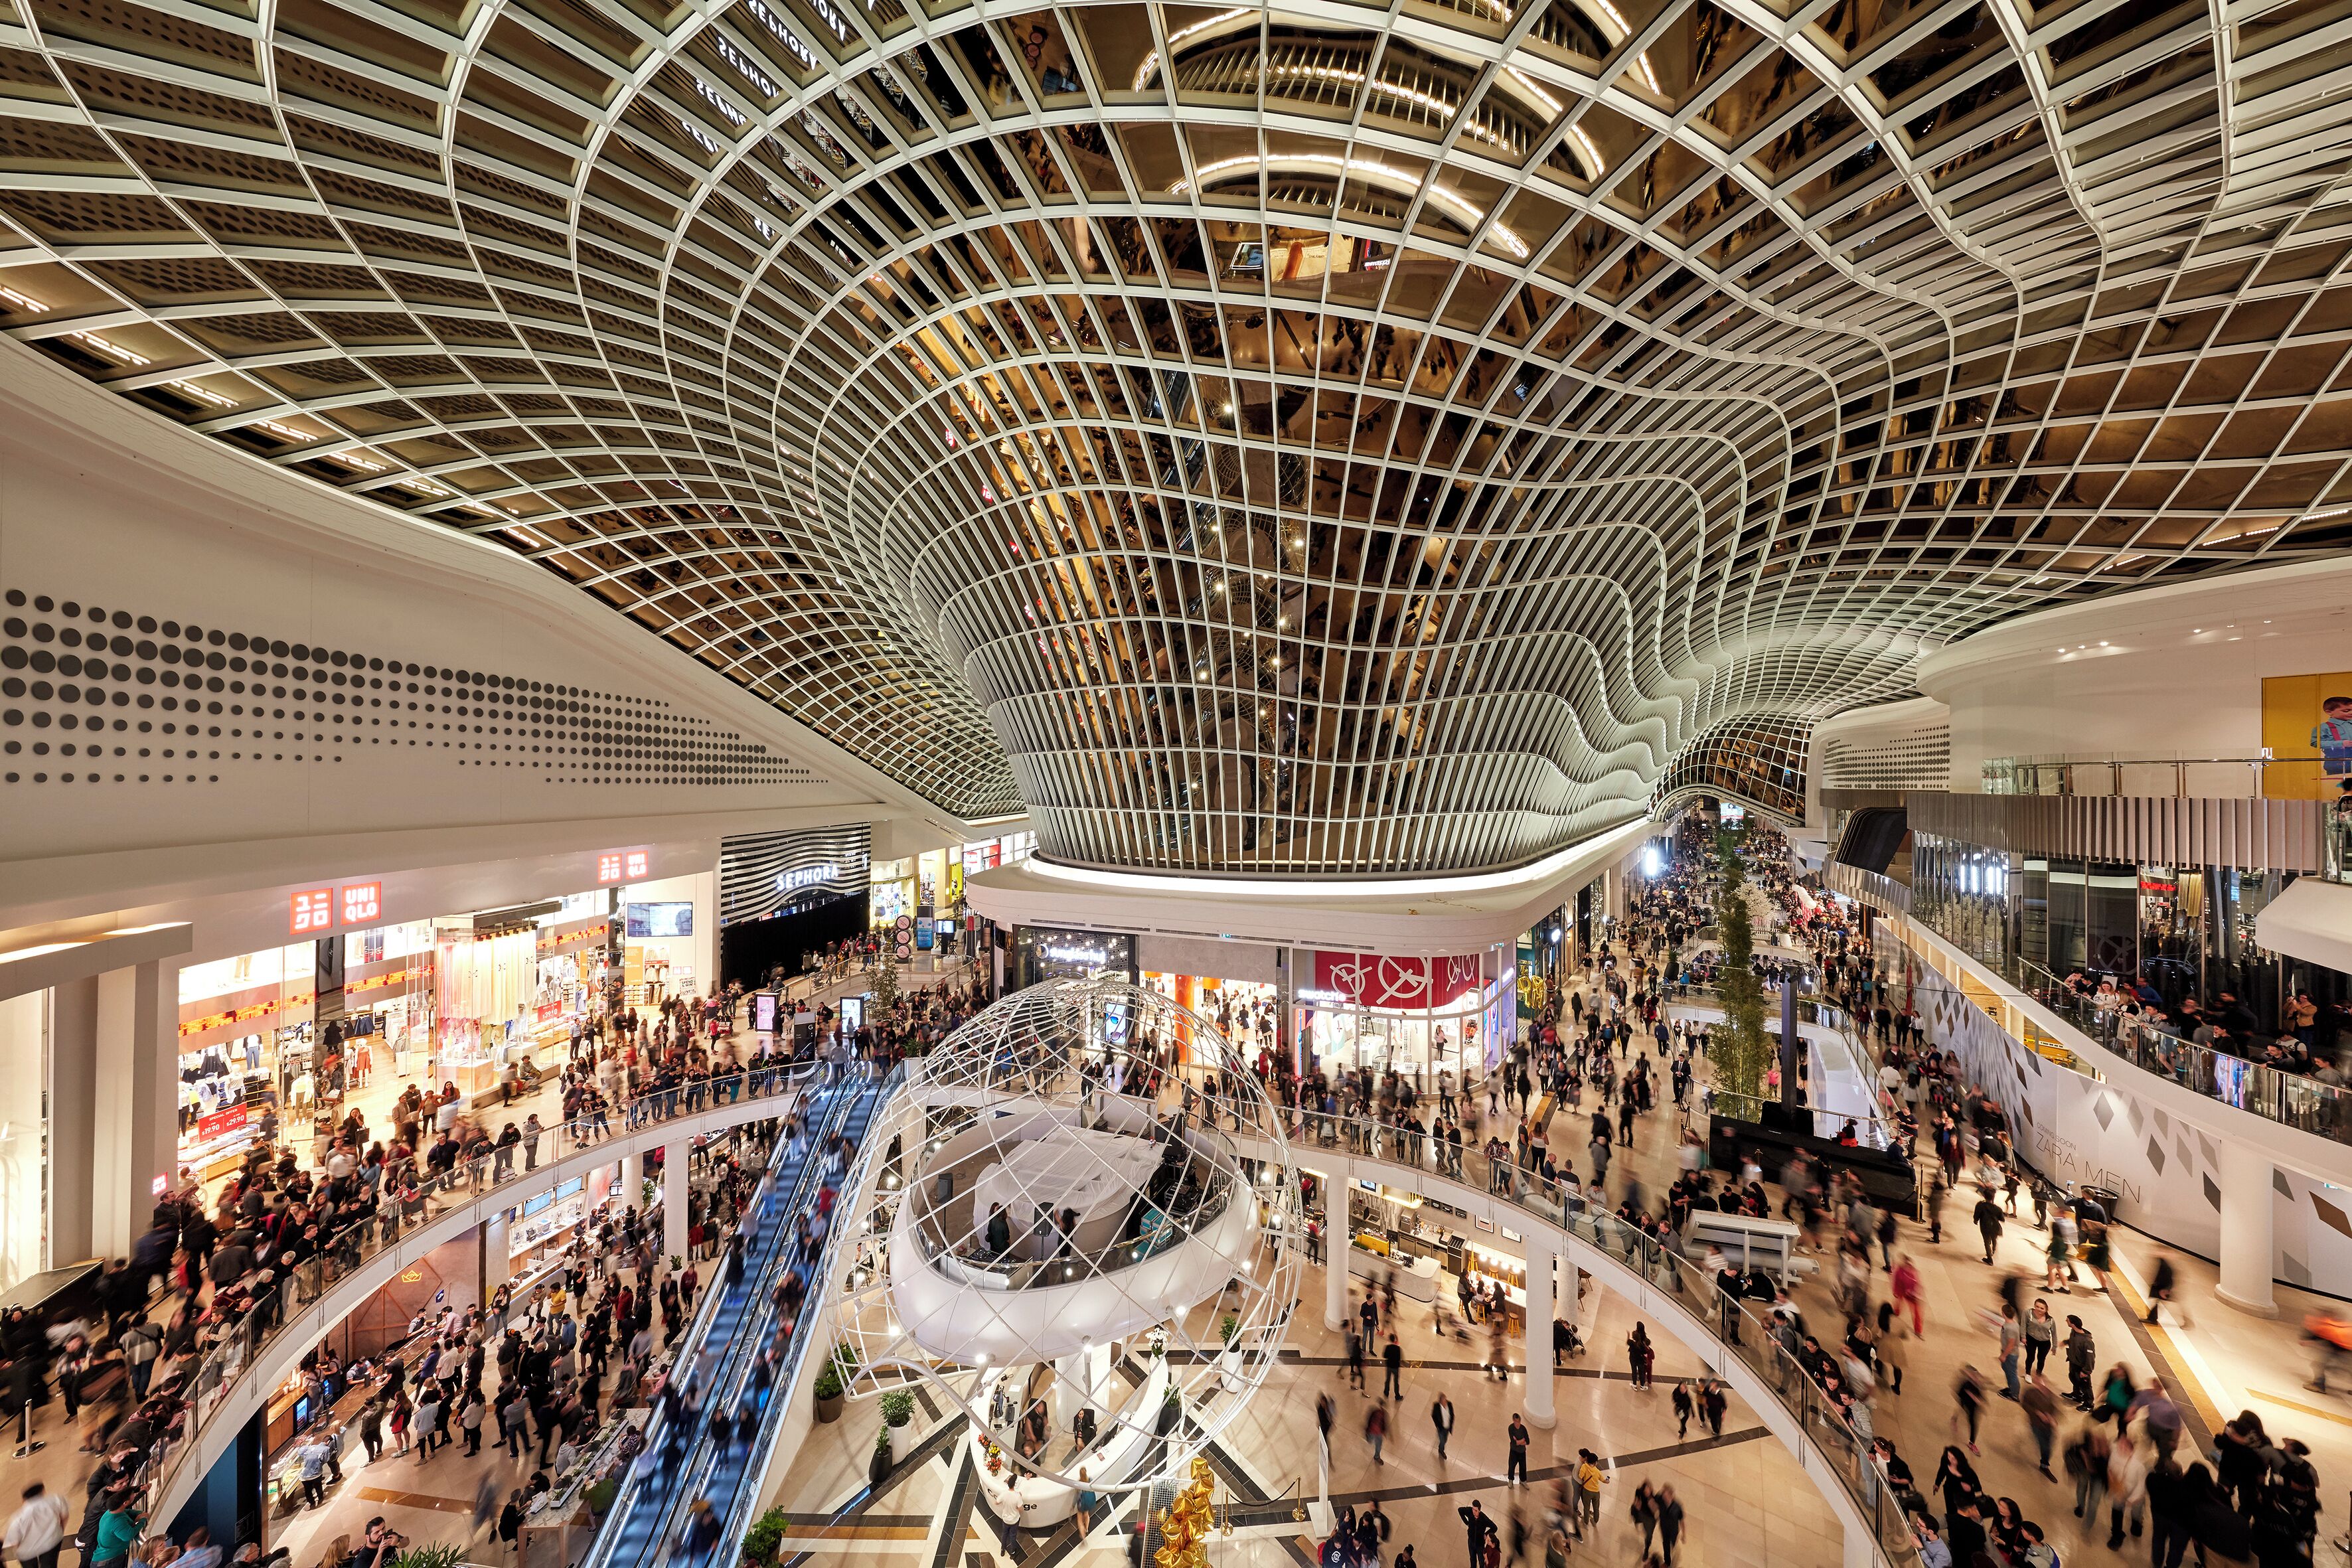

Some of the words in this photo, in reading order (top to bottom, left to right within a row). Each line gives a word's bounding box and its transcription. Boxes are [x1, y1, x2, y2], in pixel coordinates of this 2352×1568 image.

[776, 864, 839, 891] SEPHORA
[345, 886, 375, 904] UNI
[345, 902, 377, 922] QLO
[201, 1124, 220, 1136] $19.90
[226, 1115, 244, 1127] $29.90
[2037, 1122, 2055, 1139] COMING
[2056, 1135, 2077, 1151] SOON
[2036, 1131, 2077, 1172] ZARA
[2086, 1160, 2141, 1204] MEN
